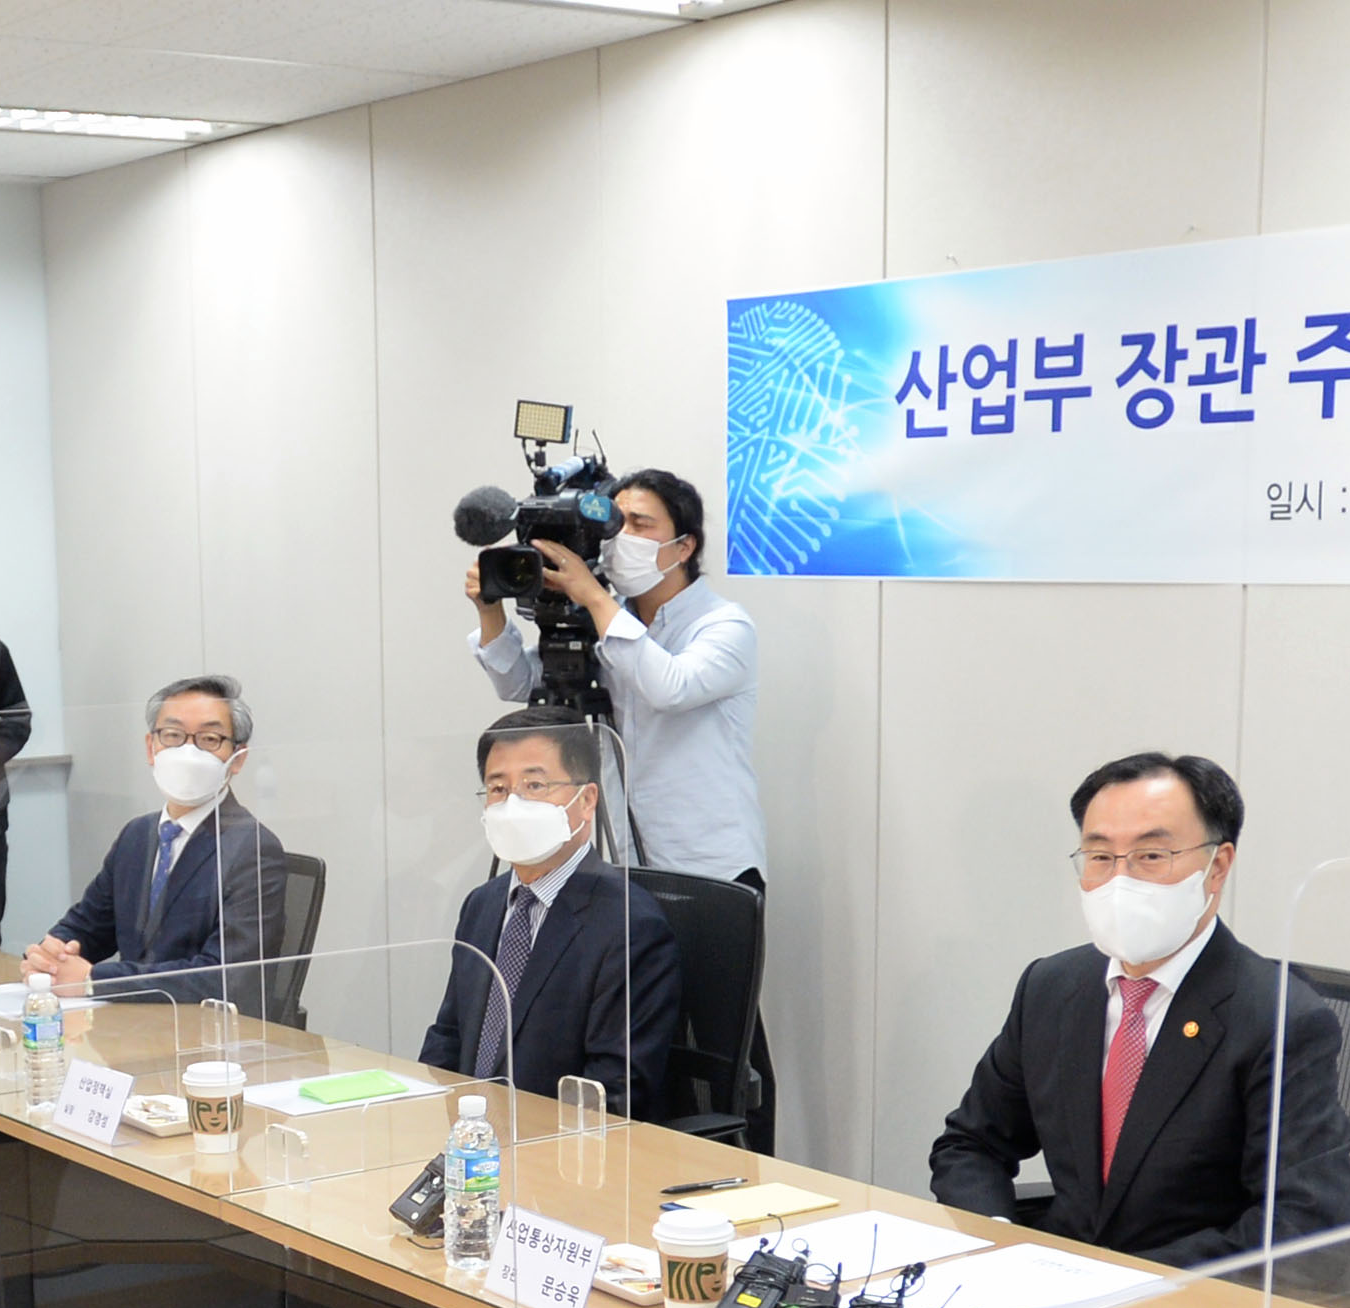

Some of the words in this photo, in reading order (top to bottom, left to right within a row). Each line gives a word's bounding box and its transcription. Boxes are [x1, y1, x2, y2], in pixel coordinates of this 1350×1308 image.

[895, 332, 1092, 438] 산업부
[1116, 318, 1266, 429] 장관
[1266, 480, 1323, 520] 일시
[506, 1220, 593, 1268] 산업통상자원부
[541, 1275, 580, 1308] 문승욱
